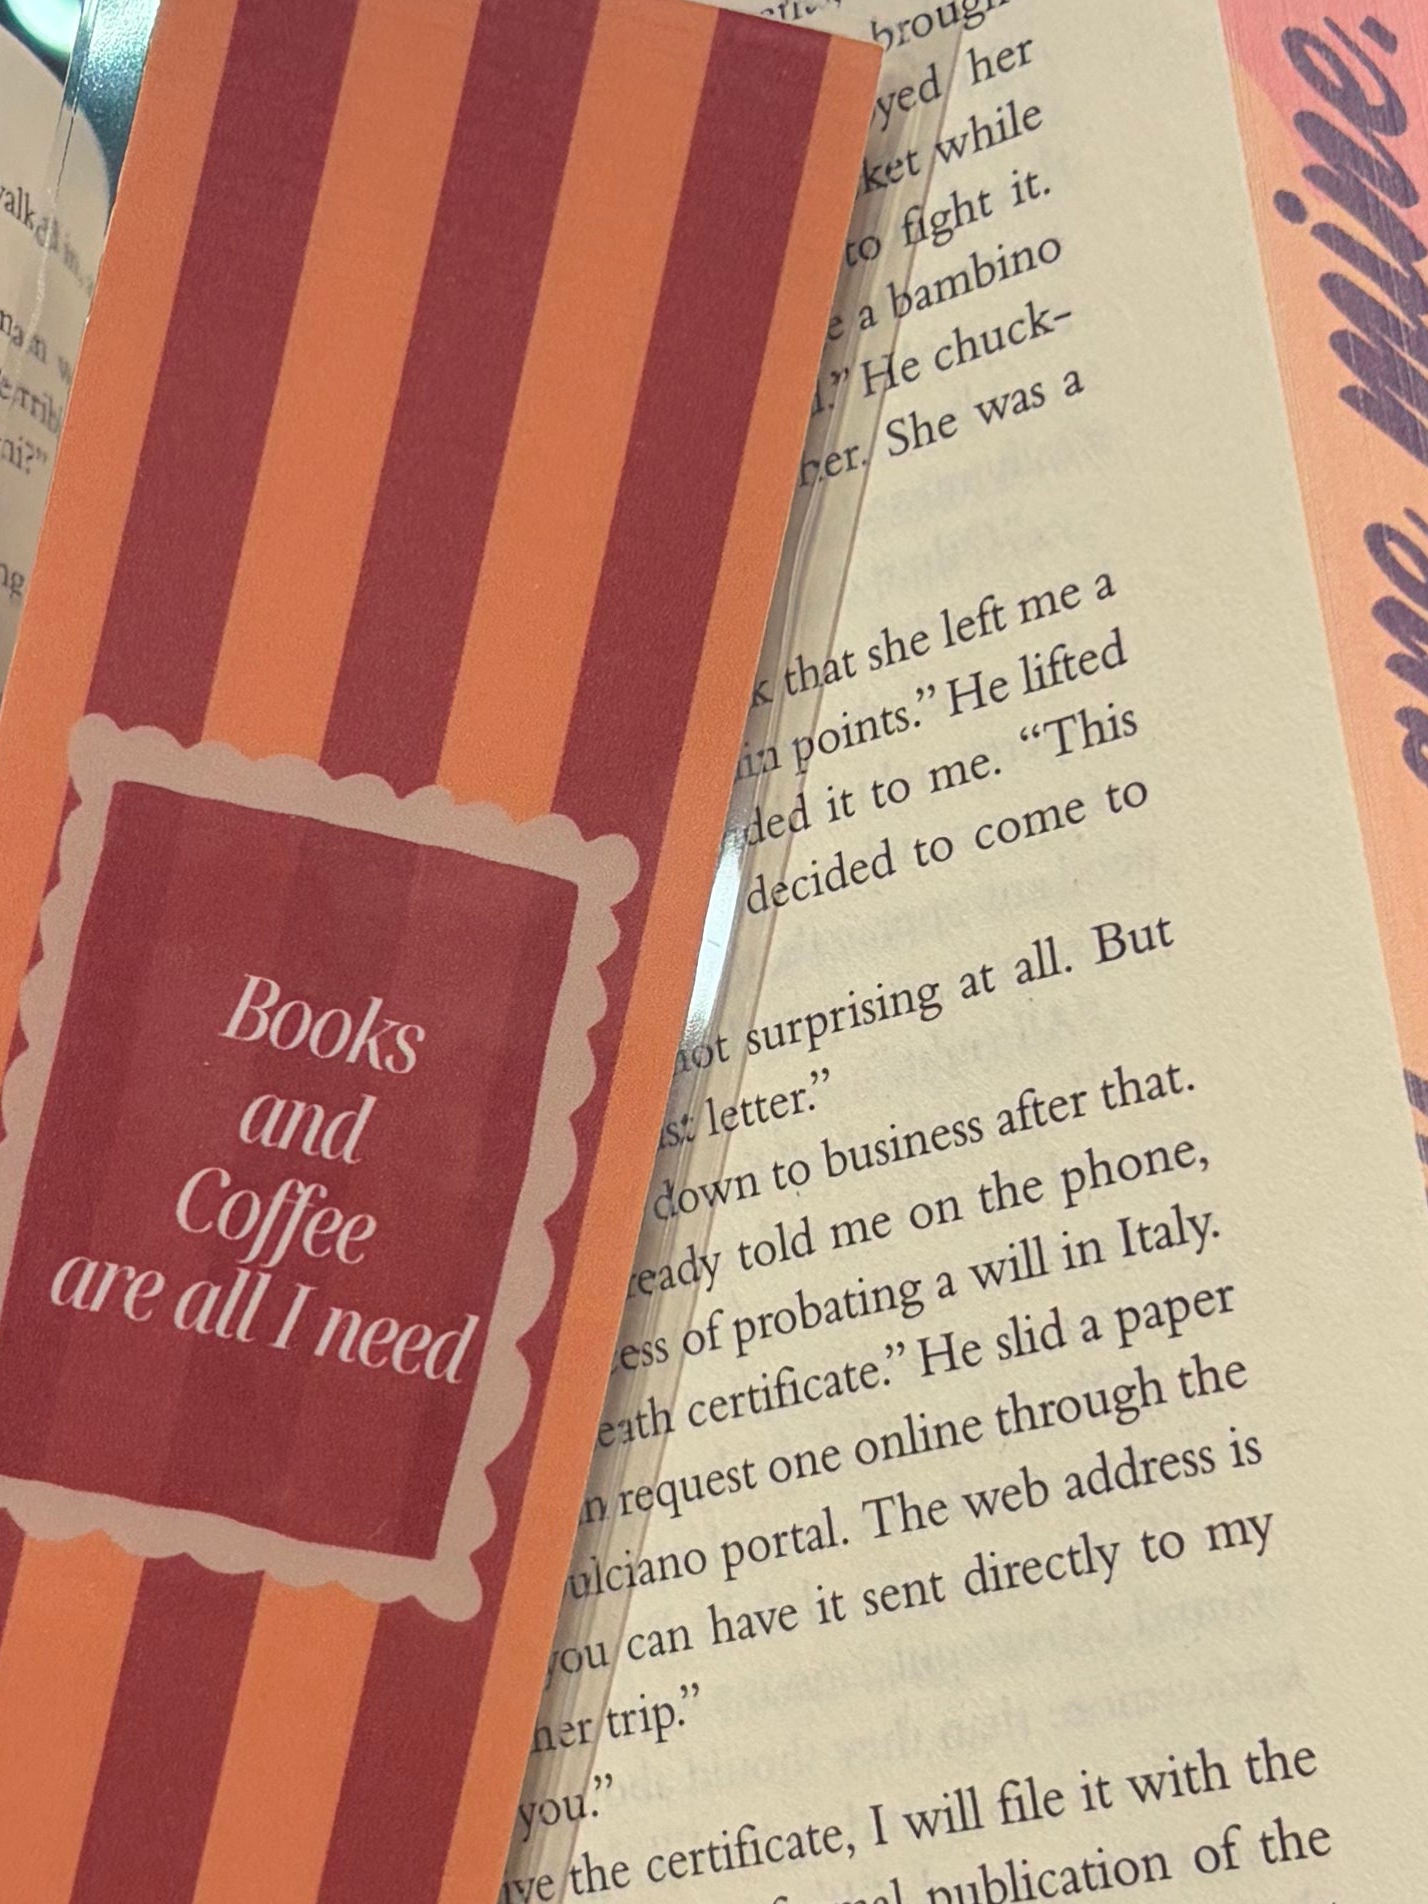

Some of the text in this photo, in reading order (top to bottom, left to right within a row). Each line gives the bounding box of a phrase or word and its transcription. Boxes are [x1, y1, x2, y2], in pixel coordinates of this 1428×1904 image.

[886, 370, 1085, 458] She was a
[783, 573, 1117, 705] that she left me a
[746, 781, 1148, 915] decided to come to
[218, 972, 426, 1075] Books
[746, 916, 1175, 1056] surprising at all. But
[238, 1092, 378, 1165] and
[653, 1063, 1195, 1222] down to business after that.
[175, 1166, 378, 1270] Coffee
[685, 1202, 1220, 1358] of probating a will in Italy.
[49, 1255, 481, 1385] are all I need
[618, 1352, 1248, 1520] request one online through the
[626, 1512, 1274, 1661] can have it sent directly to my
